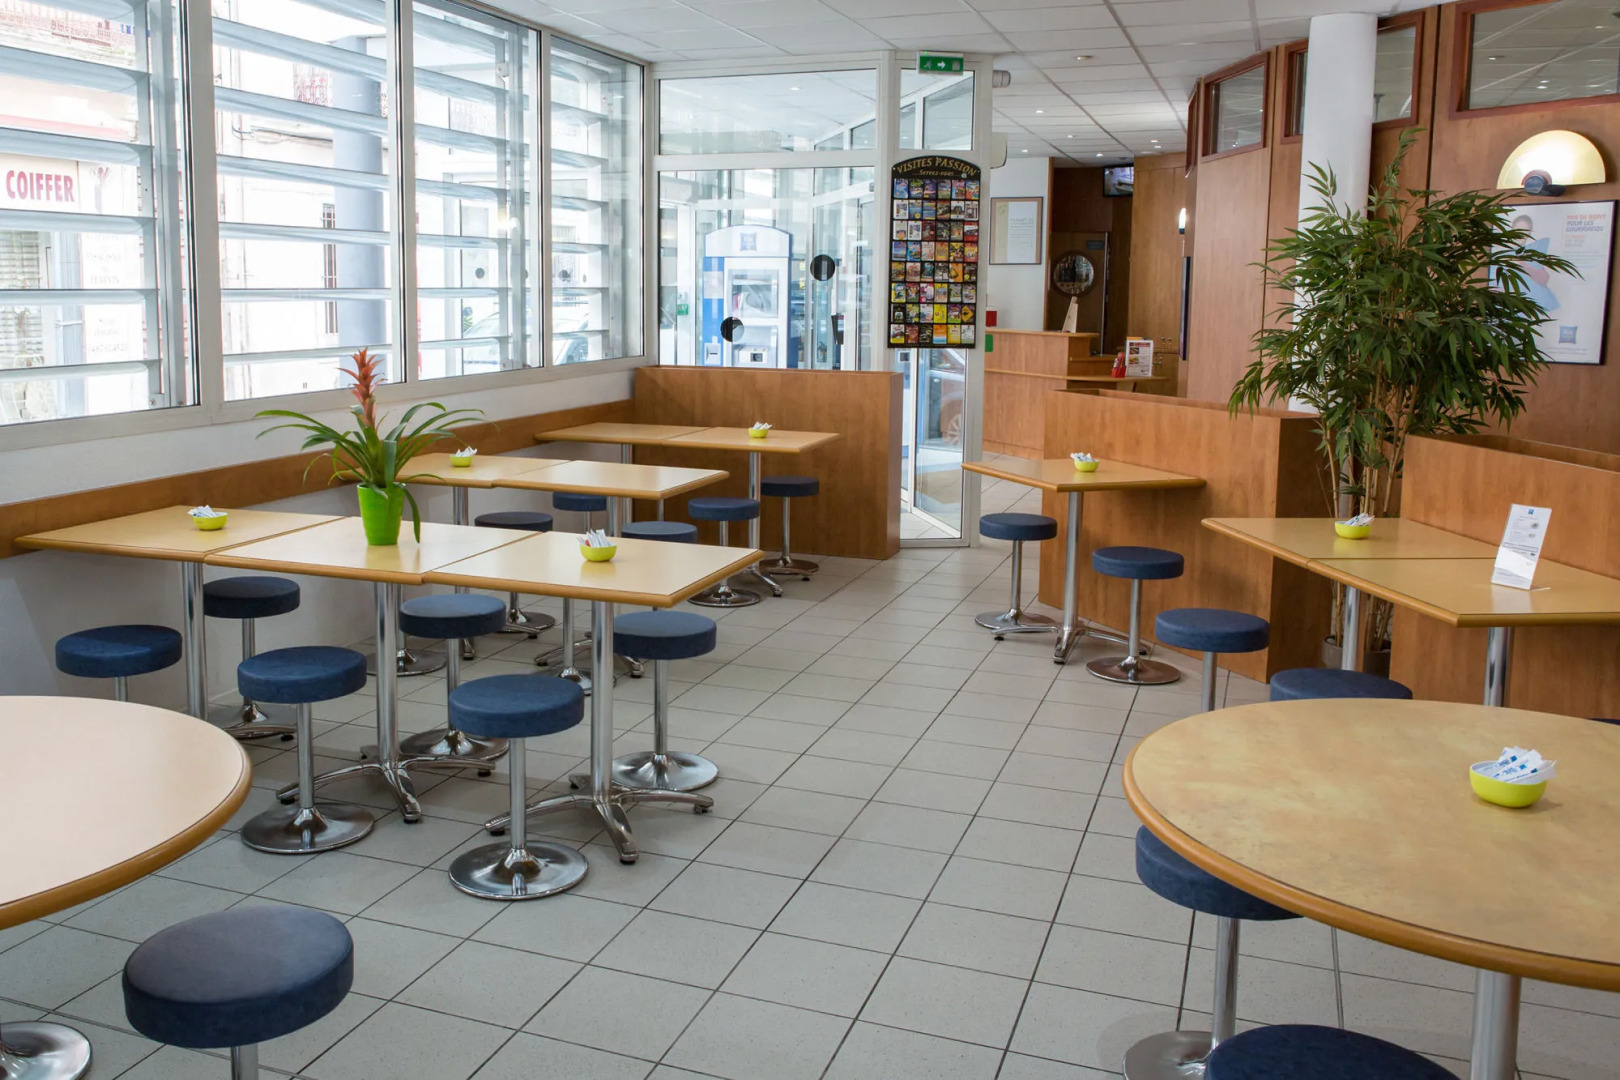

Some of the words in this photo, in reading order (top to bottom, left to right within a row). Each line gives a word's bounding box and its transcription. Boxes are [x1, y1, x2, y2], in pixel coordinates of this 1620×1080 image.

[897, 158, 932, 174] VISITES
[935, 157, 977, 176] PASSION
[6, 169, 75, 202] COIFFER
